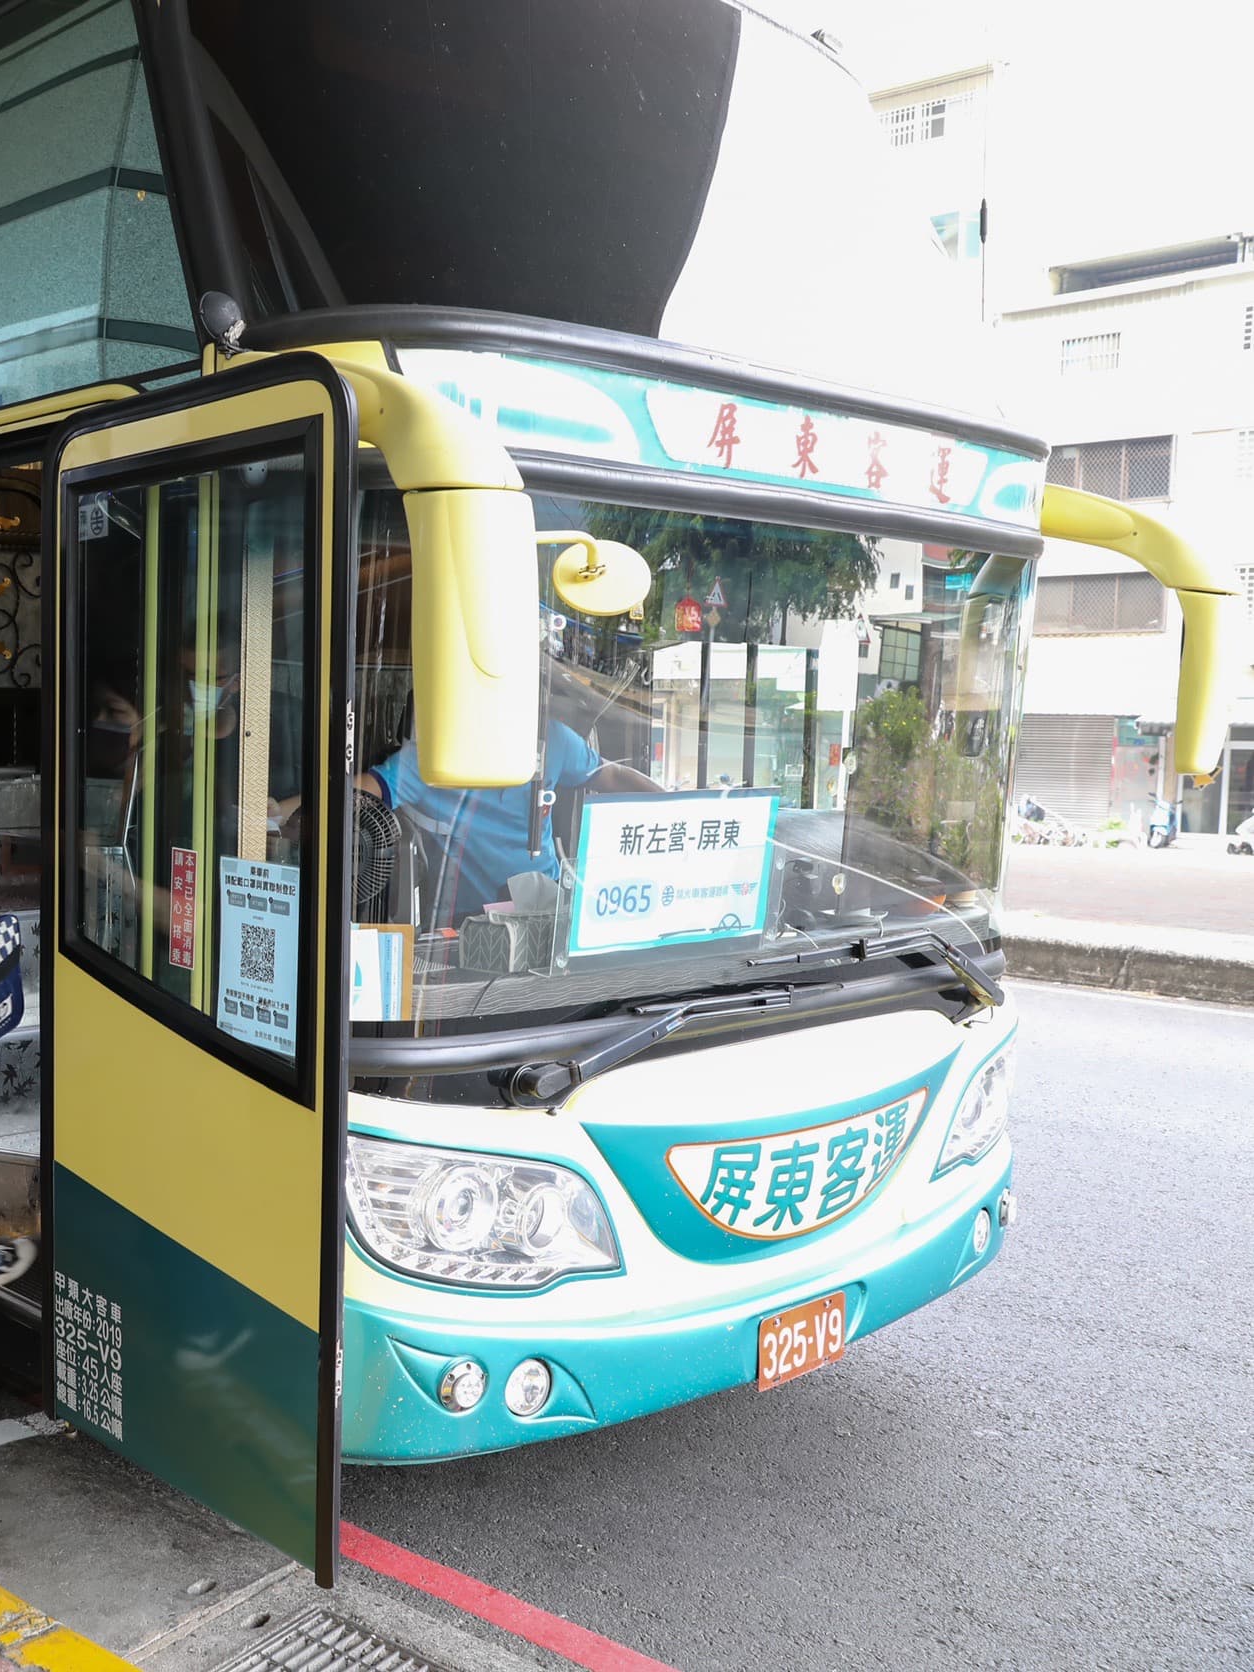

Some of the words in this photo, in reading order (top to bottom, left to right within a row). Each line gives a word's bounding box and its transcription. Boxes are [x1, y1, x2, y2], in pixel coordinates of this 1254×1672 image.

[707, 403, 952, 504] 屏東客運
[619, 819, 742, 856] 新左營-屏東
[596, 884, 652, 917] 0965
[700, 1100, 909, 1232] 屏東客運
[55, 1270, 122, 1325] 甲類大客車
[763, 1308, 842, 1379] 325-V9
